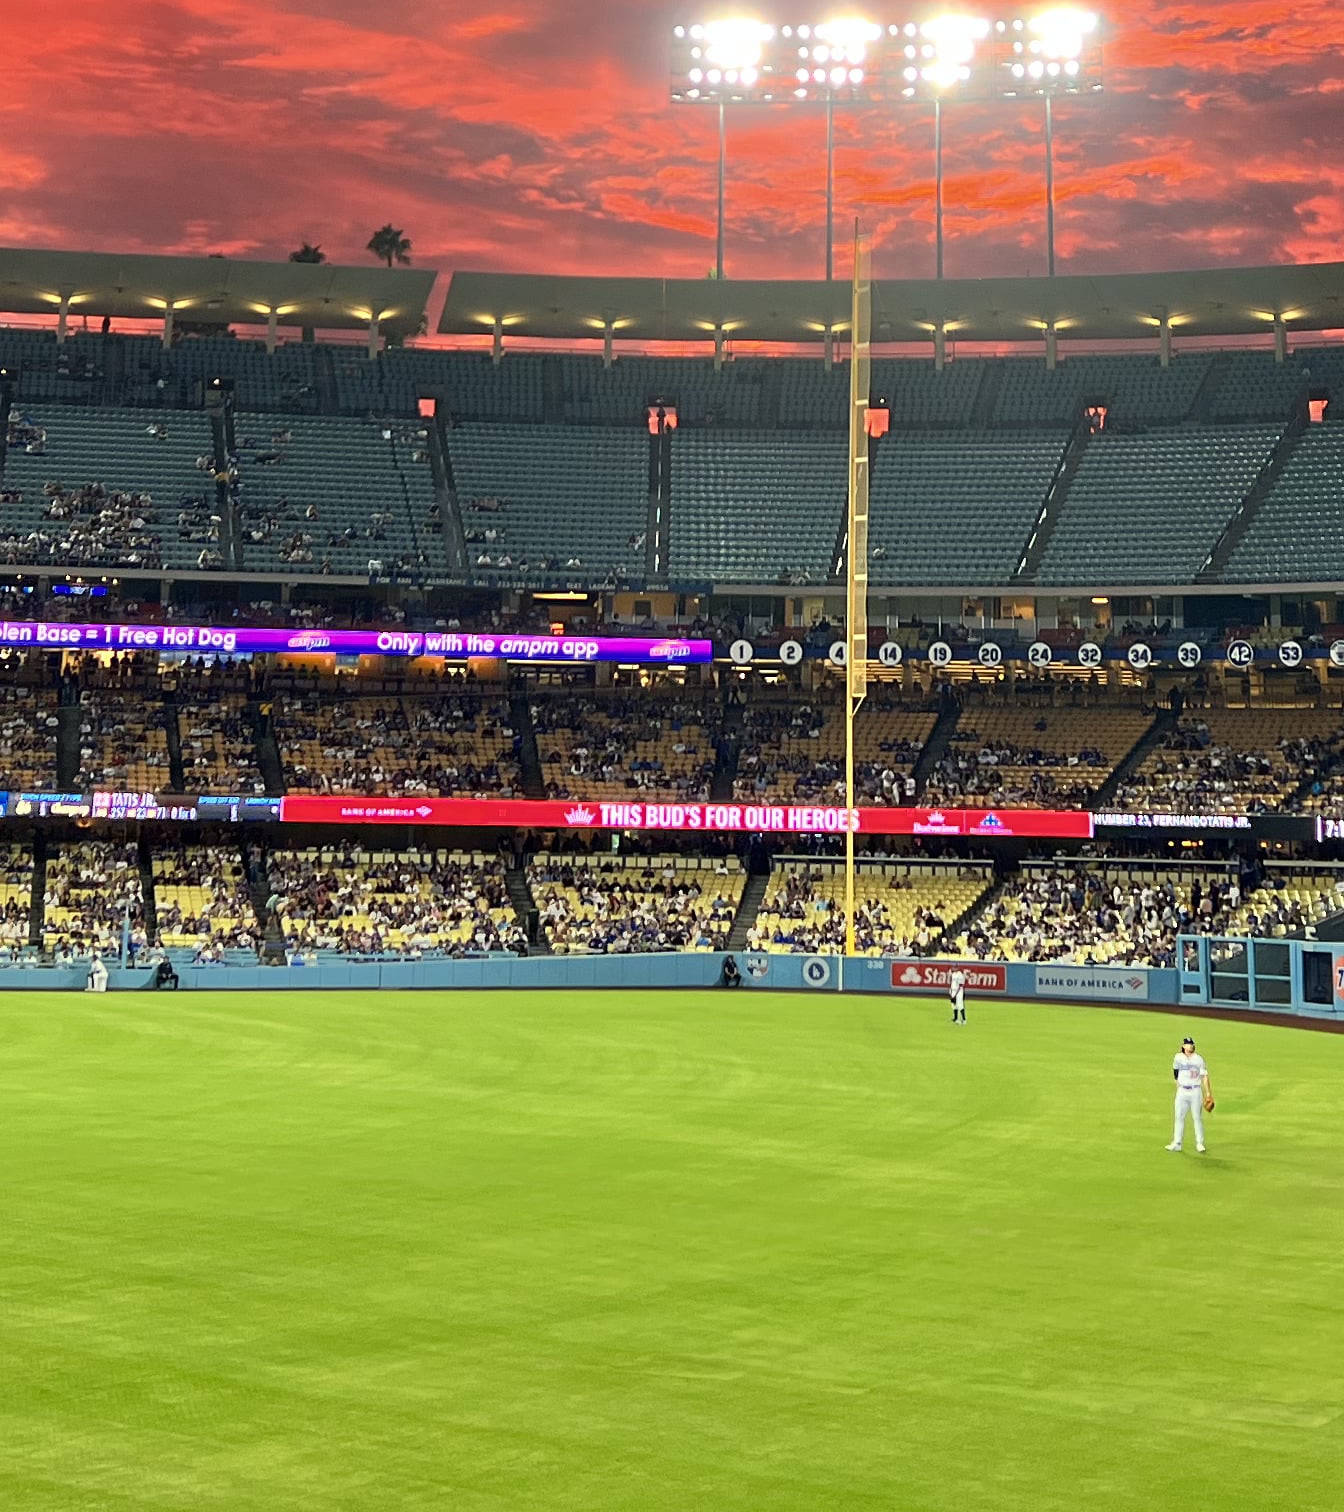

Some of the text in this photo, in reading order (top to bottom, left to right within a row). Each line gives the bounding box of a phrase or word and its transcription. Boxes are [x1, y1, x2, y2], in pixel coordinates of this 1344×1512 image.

[36, 622, 80, 642] Base
[104, 626, 112, 643] 1
[119, 626, 157, 645] Free
[163, 627, 194, 646] Hot
[198, 629, 236, 650] Dog
[377, 631, 599, 658] Only with the ampm app
[738, 645, 744, 660] 1
[787, 645, 795, 661] 2
[834, 645, 845, 661] 4
[882, 646, 897, 662] 14
[932, 646, 947, 662] 19
[981, 647, 999, 664] 20
[1030, 646, 1050, 663] 24
[1080, 646, 1098, 663] 32
[1131, 648, 1149, 664] 34
[1180, 646, 1198, 663] 39
[1230, 646, 1250, 663] 42
[1282, 646, 1299, 662] 53
[111, 792, 138, 807] TATIS
[600, 803, 860, 830] THIS BUD'S FOR OUR HEROES
[1094, 814, 1136, 826] NUMBER
[1039, 976, 1123, 990] BANK OF AMERICA
